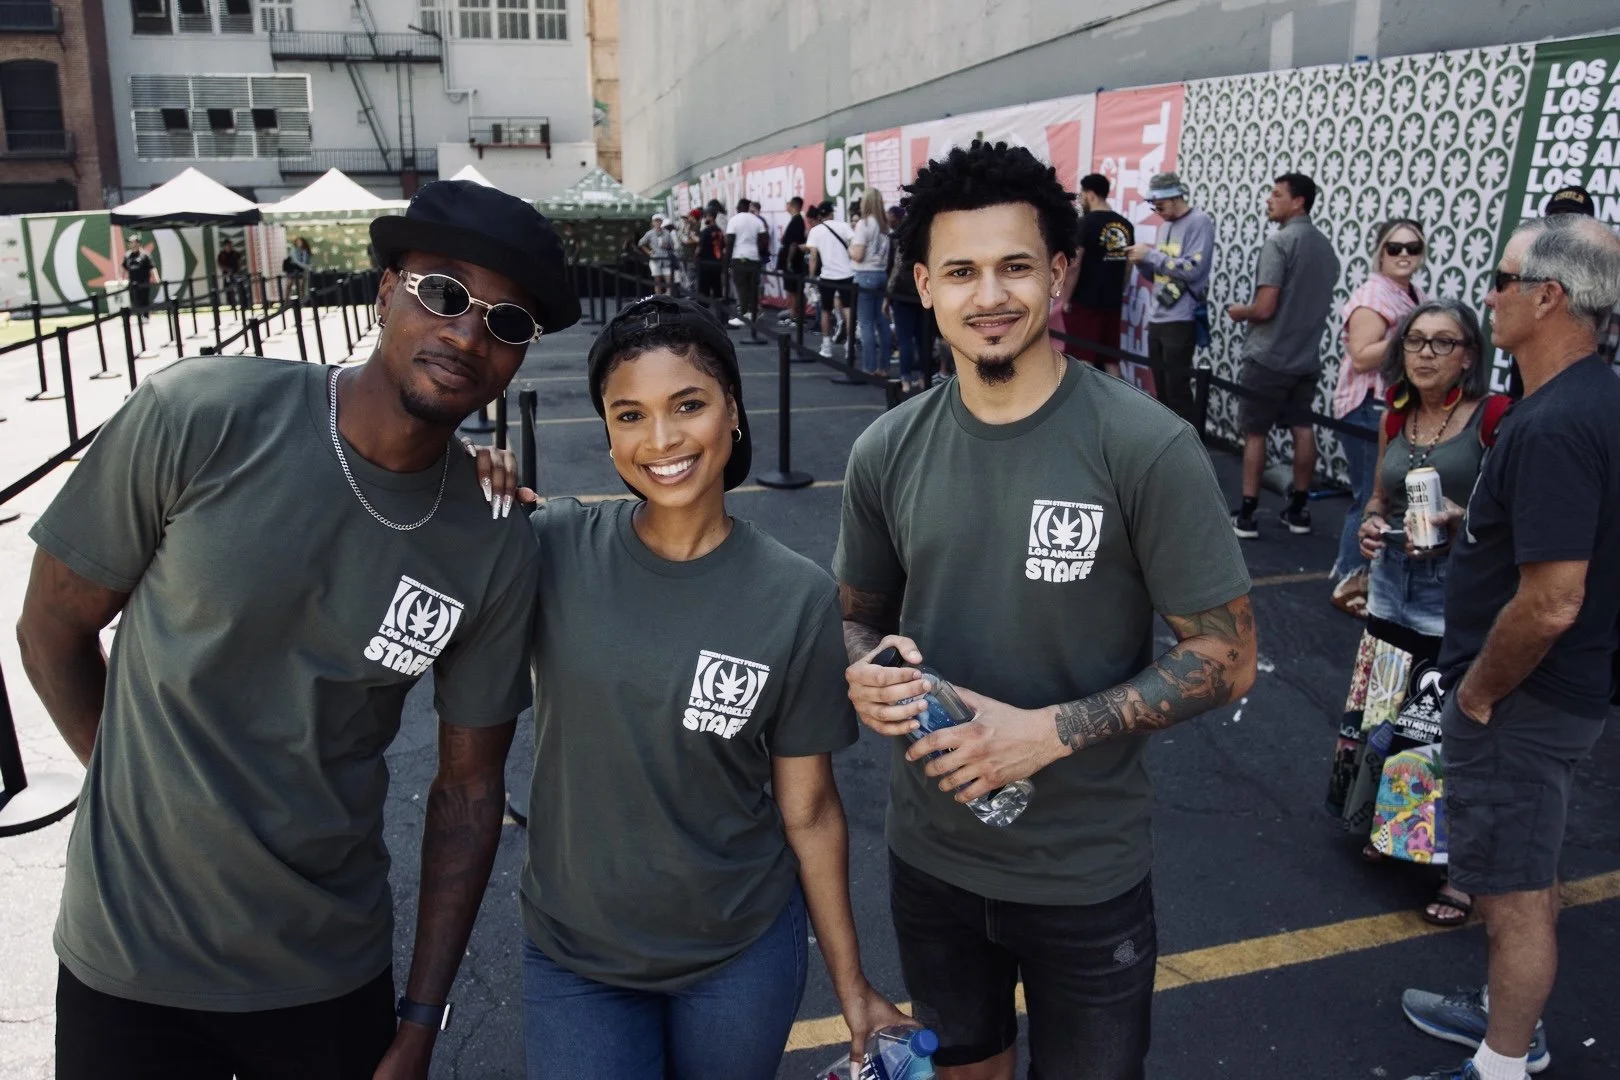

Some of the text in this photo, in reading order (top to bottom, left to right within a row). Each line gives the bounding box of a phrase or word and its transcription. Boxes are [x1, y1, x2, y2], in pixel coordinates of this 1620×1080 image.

[1547, 58, 1607, 88] LOS
[1541, 86, 1601, 114] LOS
[1536, 113, 1620, 140] LOS A
[1531, 140, 1620, 167] LOS A
[1526, 167, 1583, 193] LOS
[1521, 193, 1553, 218] LO
[1028, 546, 1096, 559] LOS ANGELES
[1025, 557, 1095, 583] STAFF
[378, 624, 442, 656] LOS ANGELES
[363, 635, 436, 677] STAFF
[688, 696, 753, 717] LOS ANGELES
[682, 707, 749, 740] STAFF
